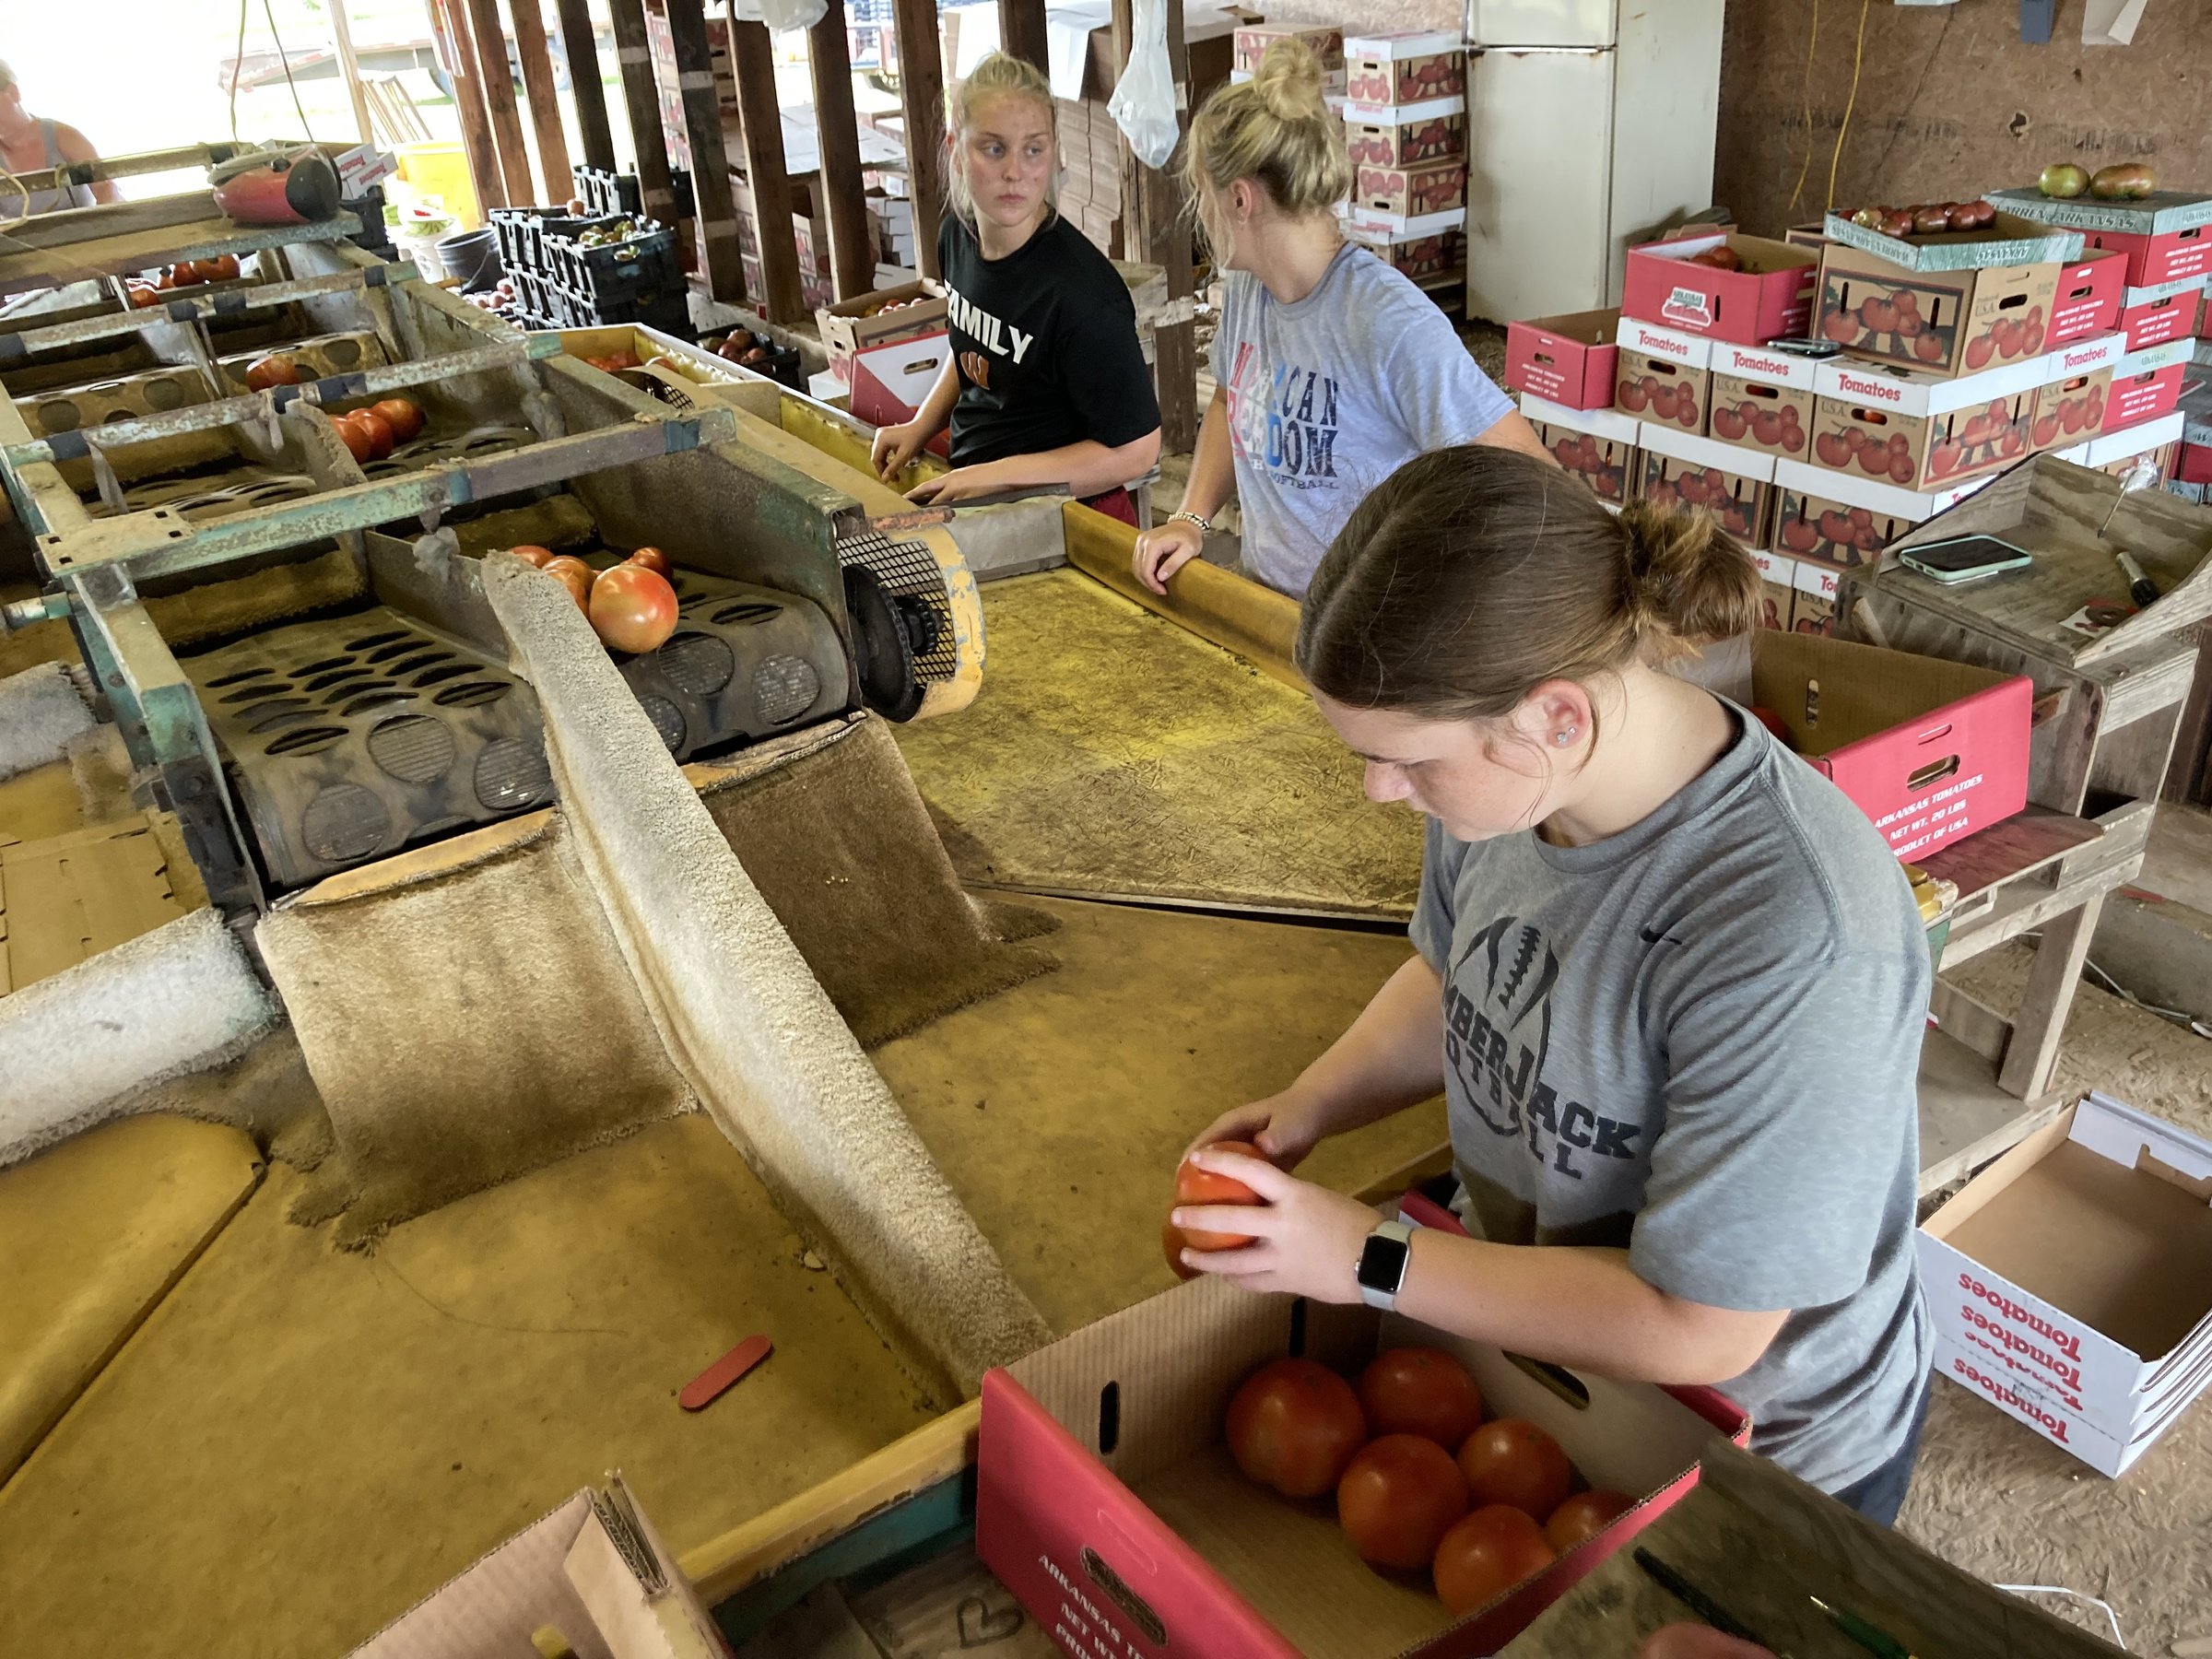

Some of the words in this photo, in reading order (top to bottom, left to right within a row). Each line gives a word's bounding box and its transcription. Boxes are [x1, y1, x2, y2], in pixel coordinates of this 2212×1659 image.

[2054, 211, 2136, 229] ARKANSAS
[1639, 330, 1688, 356] Tomatoes
[2064, 347, 2108, 370] Tomatoes
[1733, 352, 1789, 376] Tomatoes
[1839, 374, 1902, 402] Tomatoes
[1874, 799, 1929, 830] ARKANSAS
[1932, 773, 1983, 804] TOMATOES
[1889, 824, 1910, 841] NET
[1912, 817, 1928, 832] WT.
[1931, 809, 1946, 823] 20
[1947, 799, 1967, 816] LBS
[1891, 833, 1931, 858] RODUCT
[1934, 825, 1947, 840] OF
[1948, 817, 1969, 833] USA
[1959, 1273, 2081, 1363] Tomatoes
[1960, 1304, 2082, 1393] Tomatoes
[1953, 1358, 2069, 1444] Tomatoes
[1038, 1555, 1122, 1643] ARKANSAS
[1061, 1603, 1090, 1636] NET
[1055, 1623, 1092, 1659] PRO
